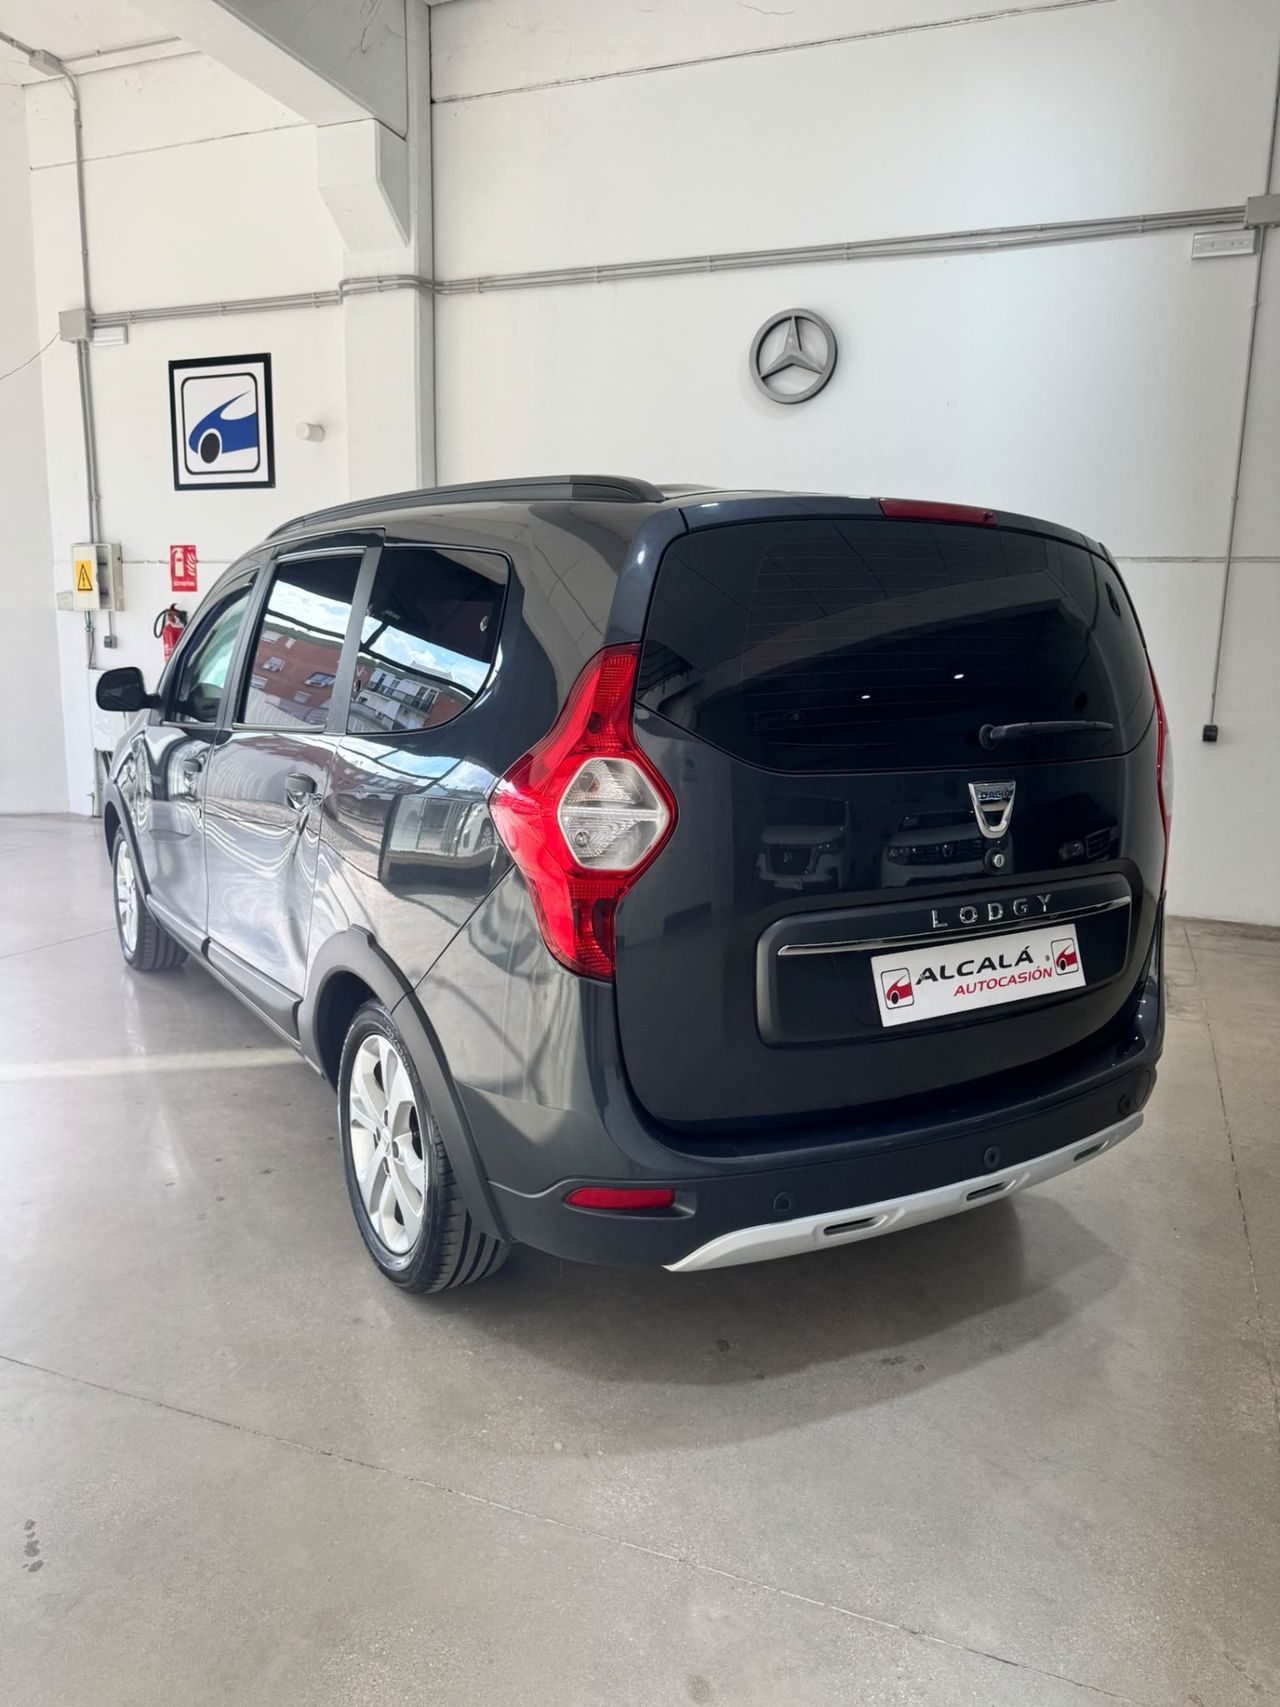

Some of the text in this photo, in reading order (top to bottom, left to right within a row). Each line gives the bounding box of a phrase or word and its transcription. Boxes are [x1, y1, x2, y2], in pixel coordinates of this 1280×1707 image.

[931, 894, 1051, 928] LODGY
[915, 945, 1034, 985] ALCALÁ
[953, 966, 1053, 997] AUTOCASIÓN
